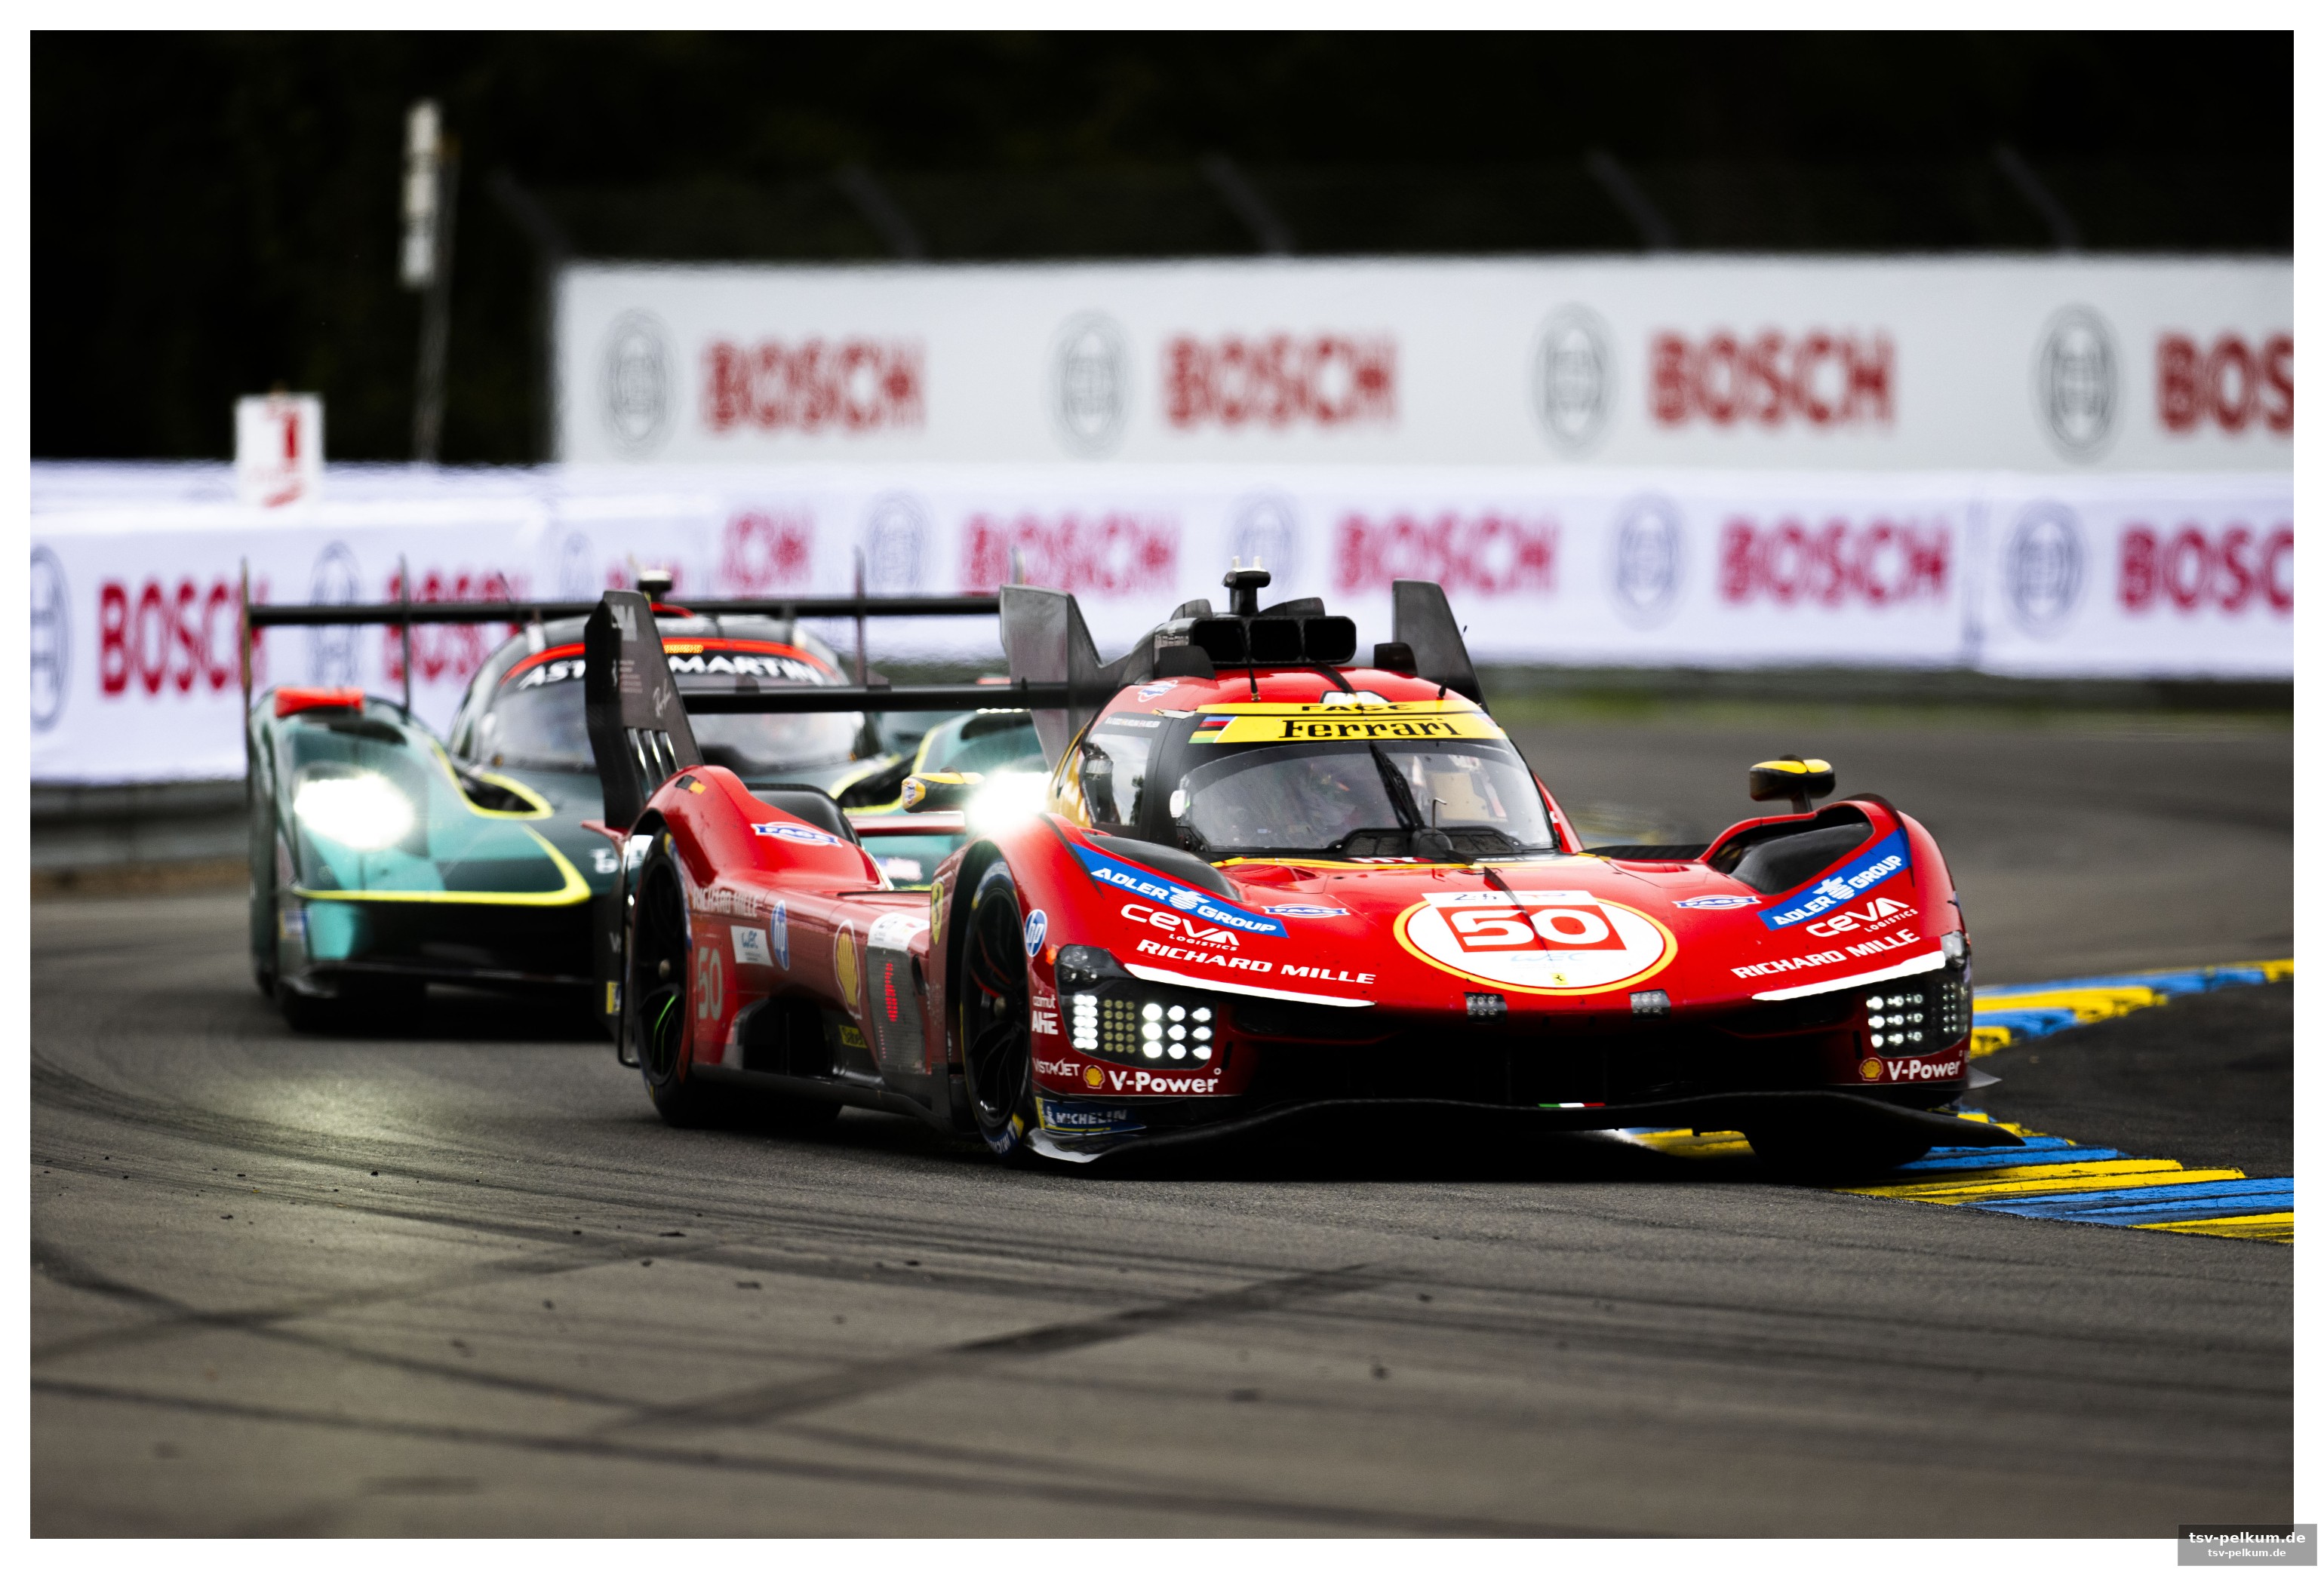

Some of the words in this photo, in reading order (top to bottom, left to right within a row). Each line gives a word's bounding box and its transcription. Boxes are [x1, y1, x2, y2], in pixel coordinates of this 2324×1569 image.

[704, 341, 922, 434] BOSCH
[1163, 335, 1396, 430] BOSCH
[1649, 332, 1894, 428] BOSCH
[964, 517, 1176, 596] BOSCH
[1335, 514, 1556, 597] BOSCH
[1720, 520, 1950, 606] BOSCH
[1279, 718, 1462, 738] Ferrari
[1091, 867, 1170, 900] ADLER
[1197, 905, 1277, 932] GROUP
[1772, 895, 1837, 926] ADLER
[1848, 855, 1902, 889] GROUP
[1864, 908, 1919, 932] LOGISTICS
[1169, 934, 1238, 951] LOGISTICS
[1450, 909, 1609, 946] 50
[1730, 950, 1848, 978] RICHARD
[1845, 929, 1921, 957] MILLE
[698, 947, 723, 1021] 50
[1136, 939, 1274, 973] RICHARD
[1280, 964, 1377, 984] MILLE
[1108, 1070, 1219, 1092] V-Power
[1887, 1060, 1961, 1080] V-Power
